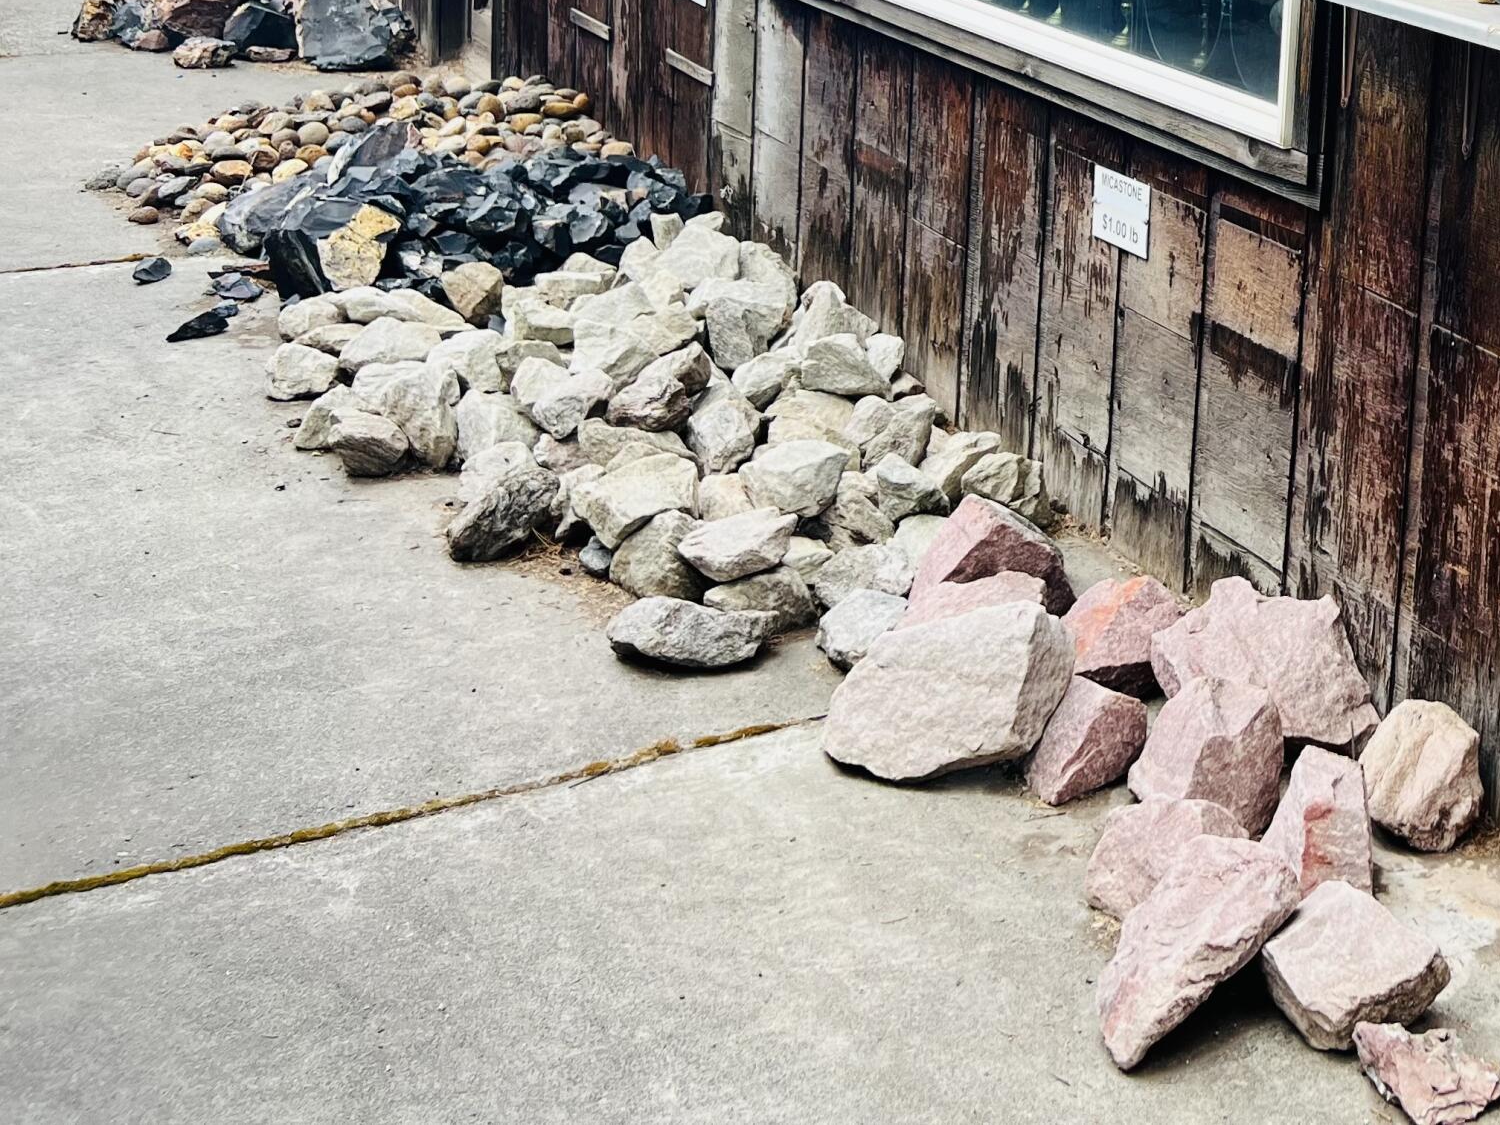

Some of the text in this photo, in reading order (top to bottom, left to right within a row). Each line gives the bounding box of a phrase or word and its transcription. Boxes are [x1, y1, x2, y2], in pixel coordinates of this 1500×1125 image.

[1101, 172, 1143, 202] MICASTONE
[1102, 213, 1139, 244] $1.00 lb
